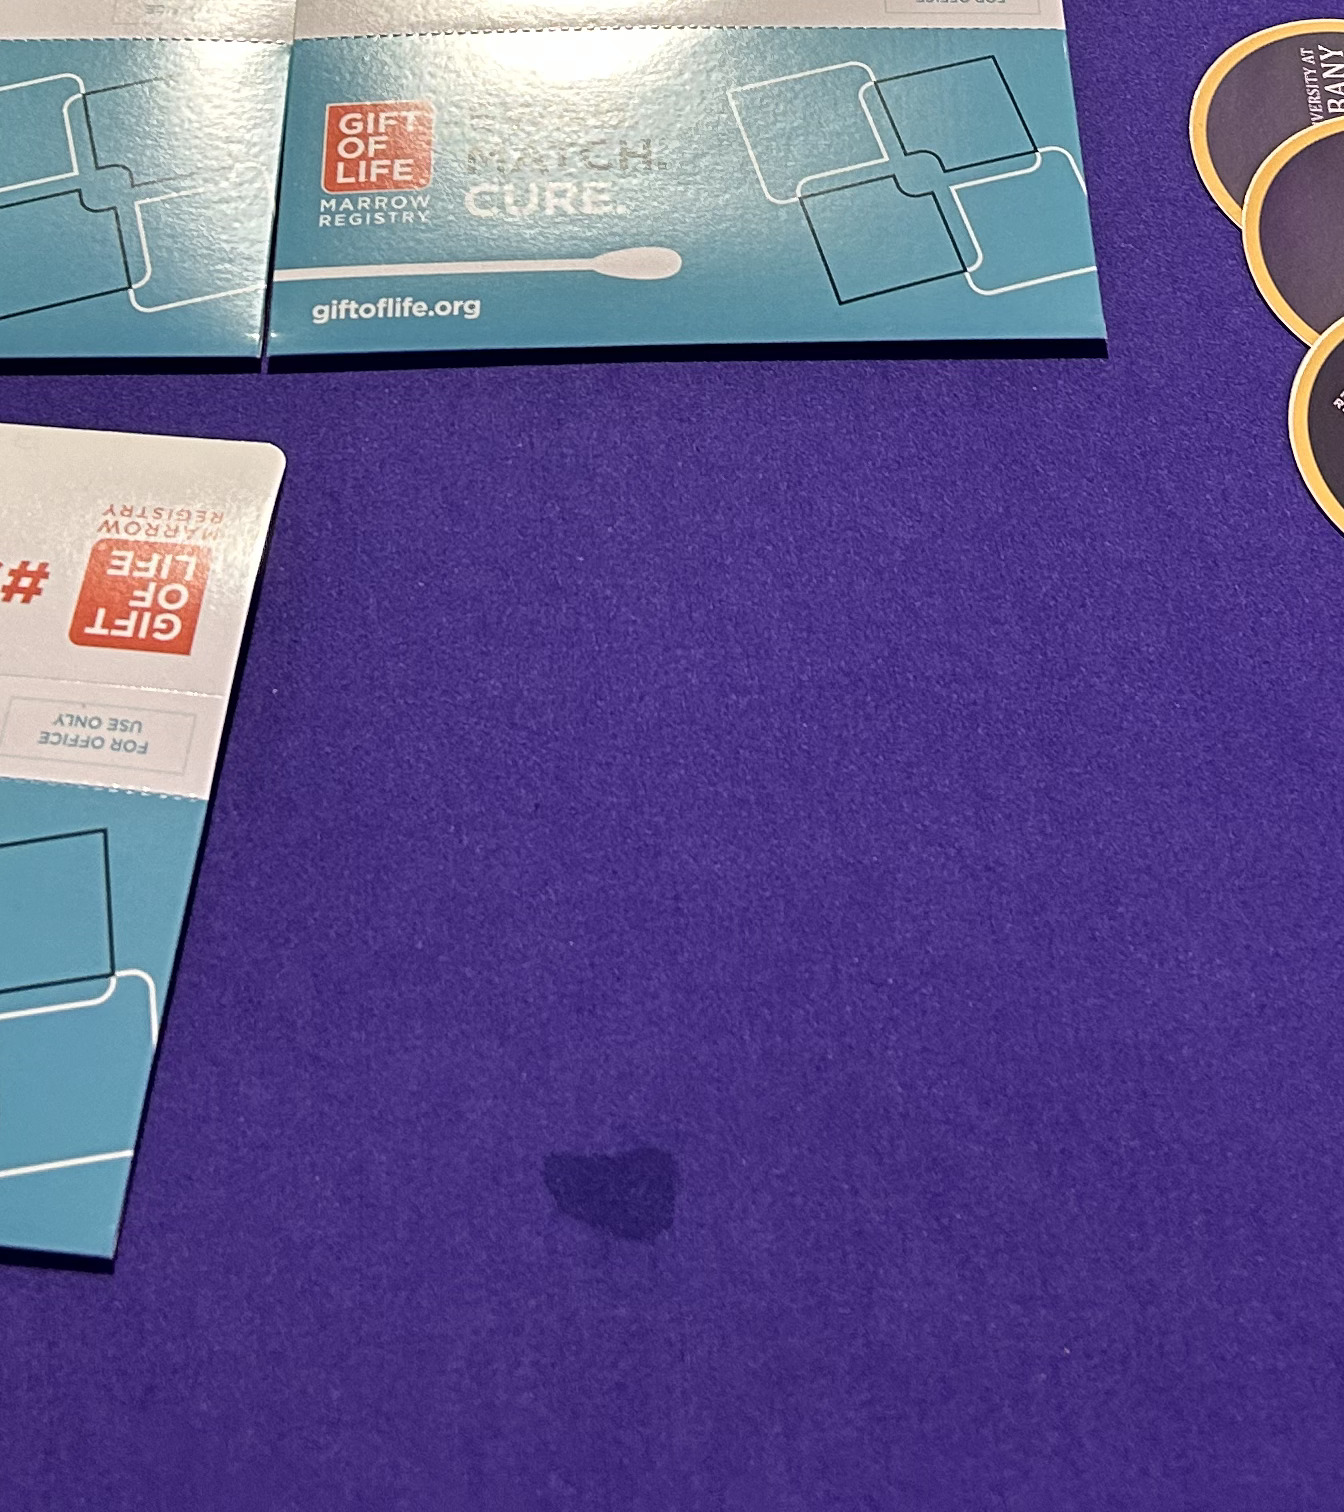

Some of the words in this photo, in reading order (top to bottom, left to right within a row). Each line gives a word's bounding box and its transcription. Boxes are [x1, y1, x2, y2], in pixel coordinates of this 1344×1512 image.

[338, 110, 421, 136] GIFT
[337, 136, 388, 159] OF
[335, 159, 414, 184] LIFE
[320, 195, 430, 212] MARROW
[465, 182, 629, 217] CURE.
[319, 211, 430, 227] REGISTRY
[312, 297, 481, 324] giftoflife.org
[103, 504, 224, 524] REGISTRY
[107, 550, 197, 580] LIFE
[129, 582, 188, 610] OF
[84, 608, 182, 640] GIFT
[53, 712, 103, 730] ONLY
[108, 717, 142, 733] USE
[37, 730, 104, 750] OFFICE
[111, 738, 149, 755] FOR
